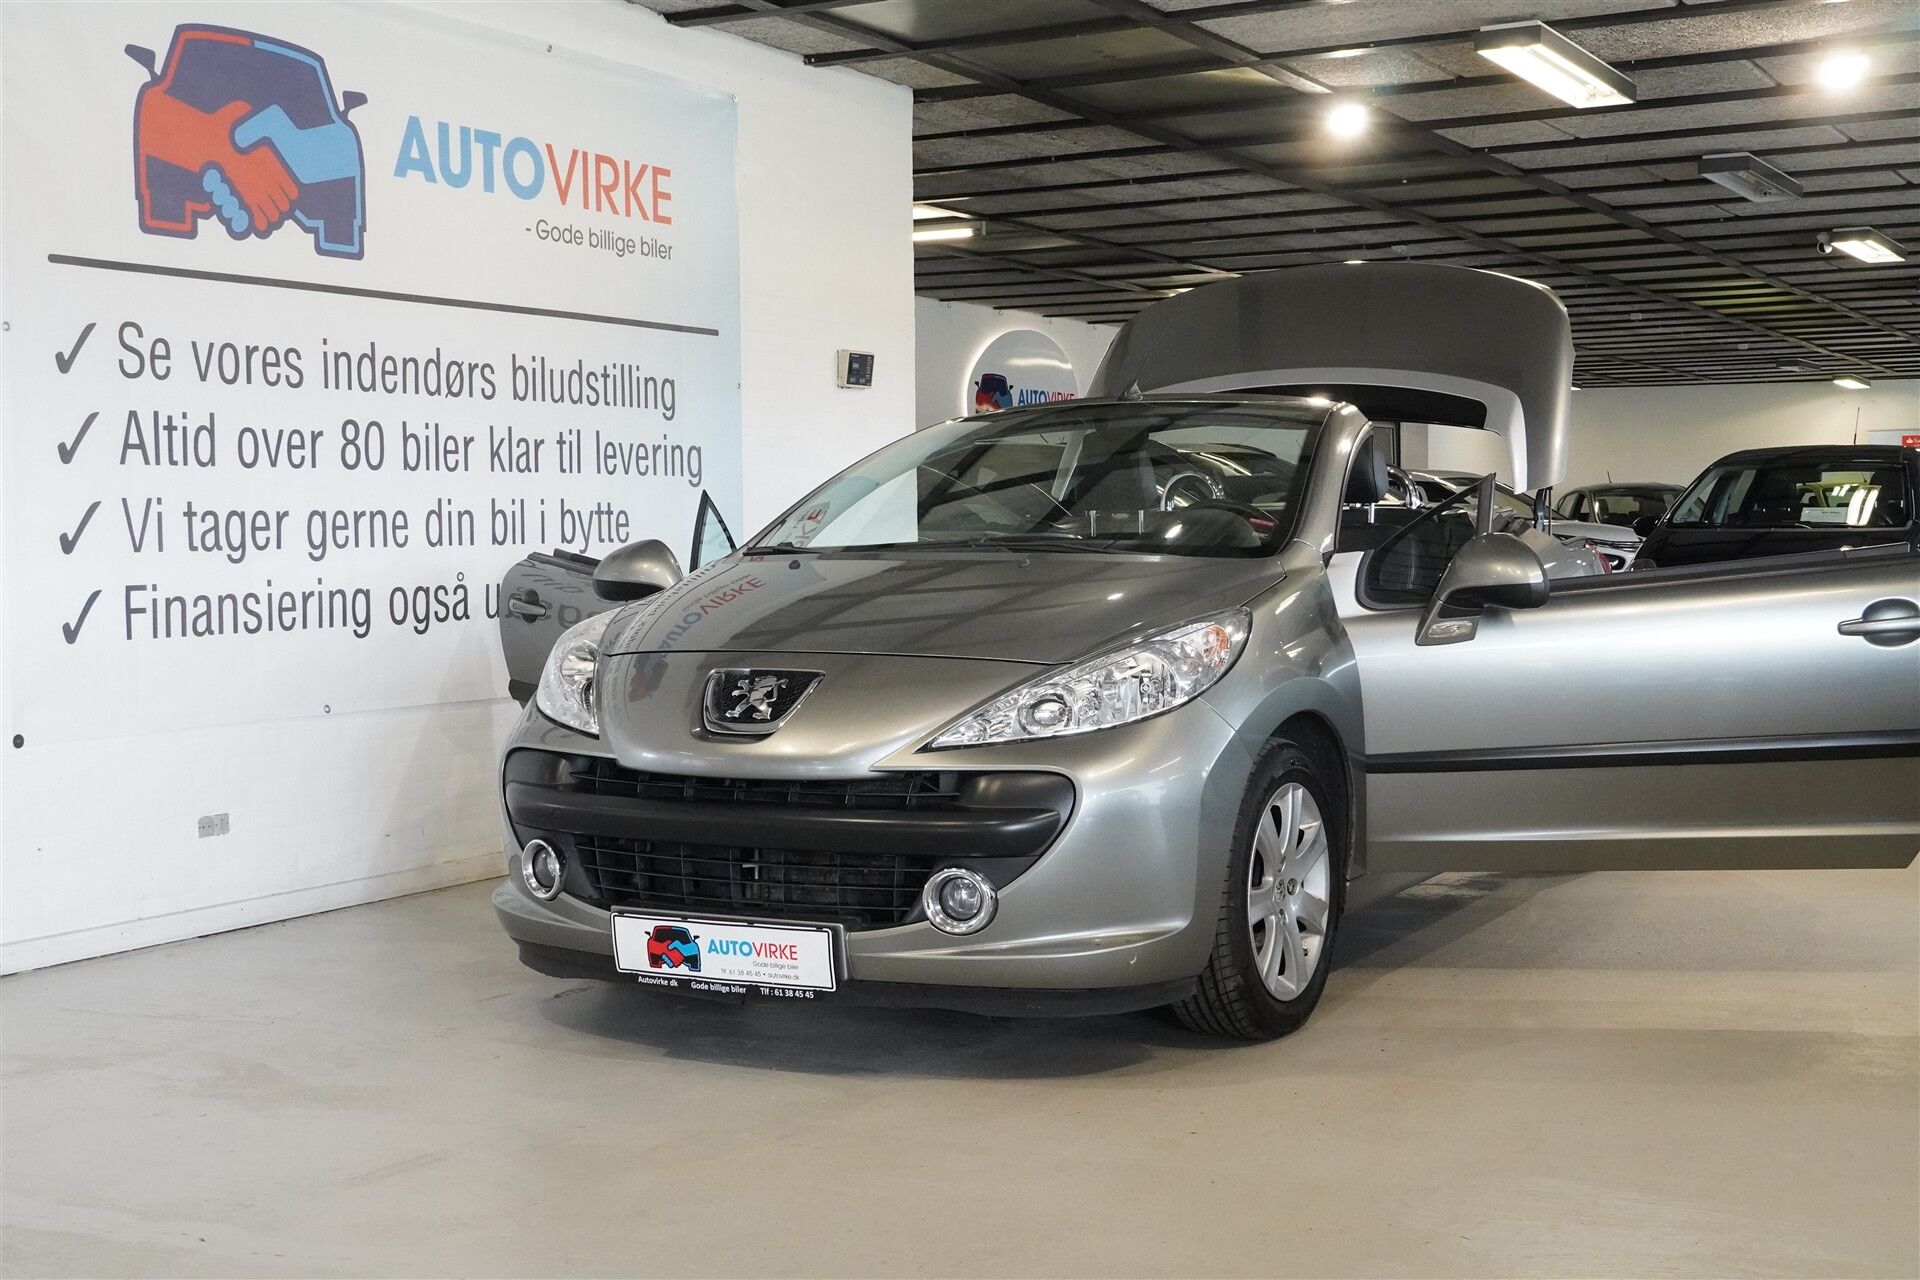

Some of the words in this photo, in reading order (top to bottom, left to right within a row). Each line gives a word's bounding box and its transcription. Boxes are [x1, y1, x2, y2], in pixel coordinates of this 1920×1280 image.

[394, 116, 673, 226] AUTOVIRKE
[535, 219, 585, 247] Gode
[588, 227, 637, 259] billige
[640, 235, 673, 261] biler
[118, 320, 172, 381] Se
[190, 340, 305, 390] vores
[322, 337, 497, 401] indendørs
[511, 354, 676, 422] biludstilling
[119, 409, 216, 468] Altid
[237, 426, 324, 470] over
[340, 418, 385, 472] 80
[401, 420, 475, 473] biler
[489, 425, 545, 474] klar
[556, 428, 582, 474] til
[595, 430, 703, 488] levering
[121, 496, 164, 553] Vi
[182, 500, 290, 565] tager
[306, 509, 409, 563] gerne
[425, 497, 475, 548] din
[490, 497, 526, 547] bil
[540, 498, 546, 545] i
[560, 497, 630, 552] bytte
[124, 577, 372, 641] Finansiering
[389, 571, 471, 636] også
[707, 938, 798, 961] AUTOVIRKE
[752, 960, 769, 969] Gode
[770, 962, 787, 971] billige
[638, 976, 669, 986] Autovirke
[690, 982, 709, 990] Gode
[709, 983, 730, 993] billige
[731, 985, 746, 994] biler
[774, 988, 783, 997] 61
[784, 989, 794, 997] 38
[794, 990, 804, 998] 45
[804, 991, 814, 999] 45
